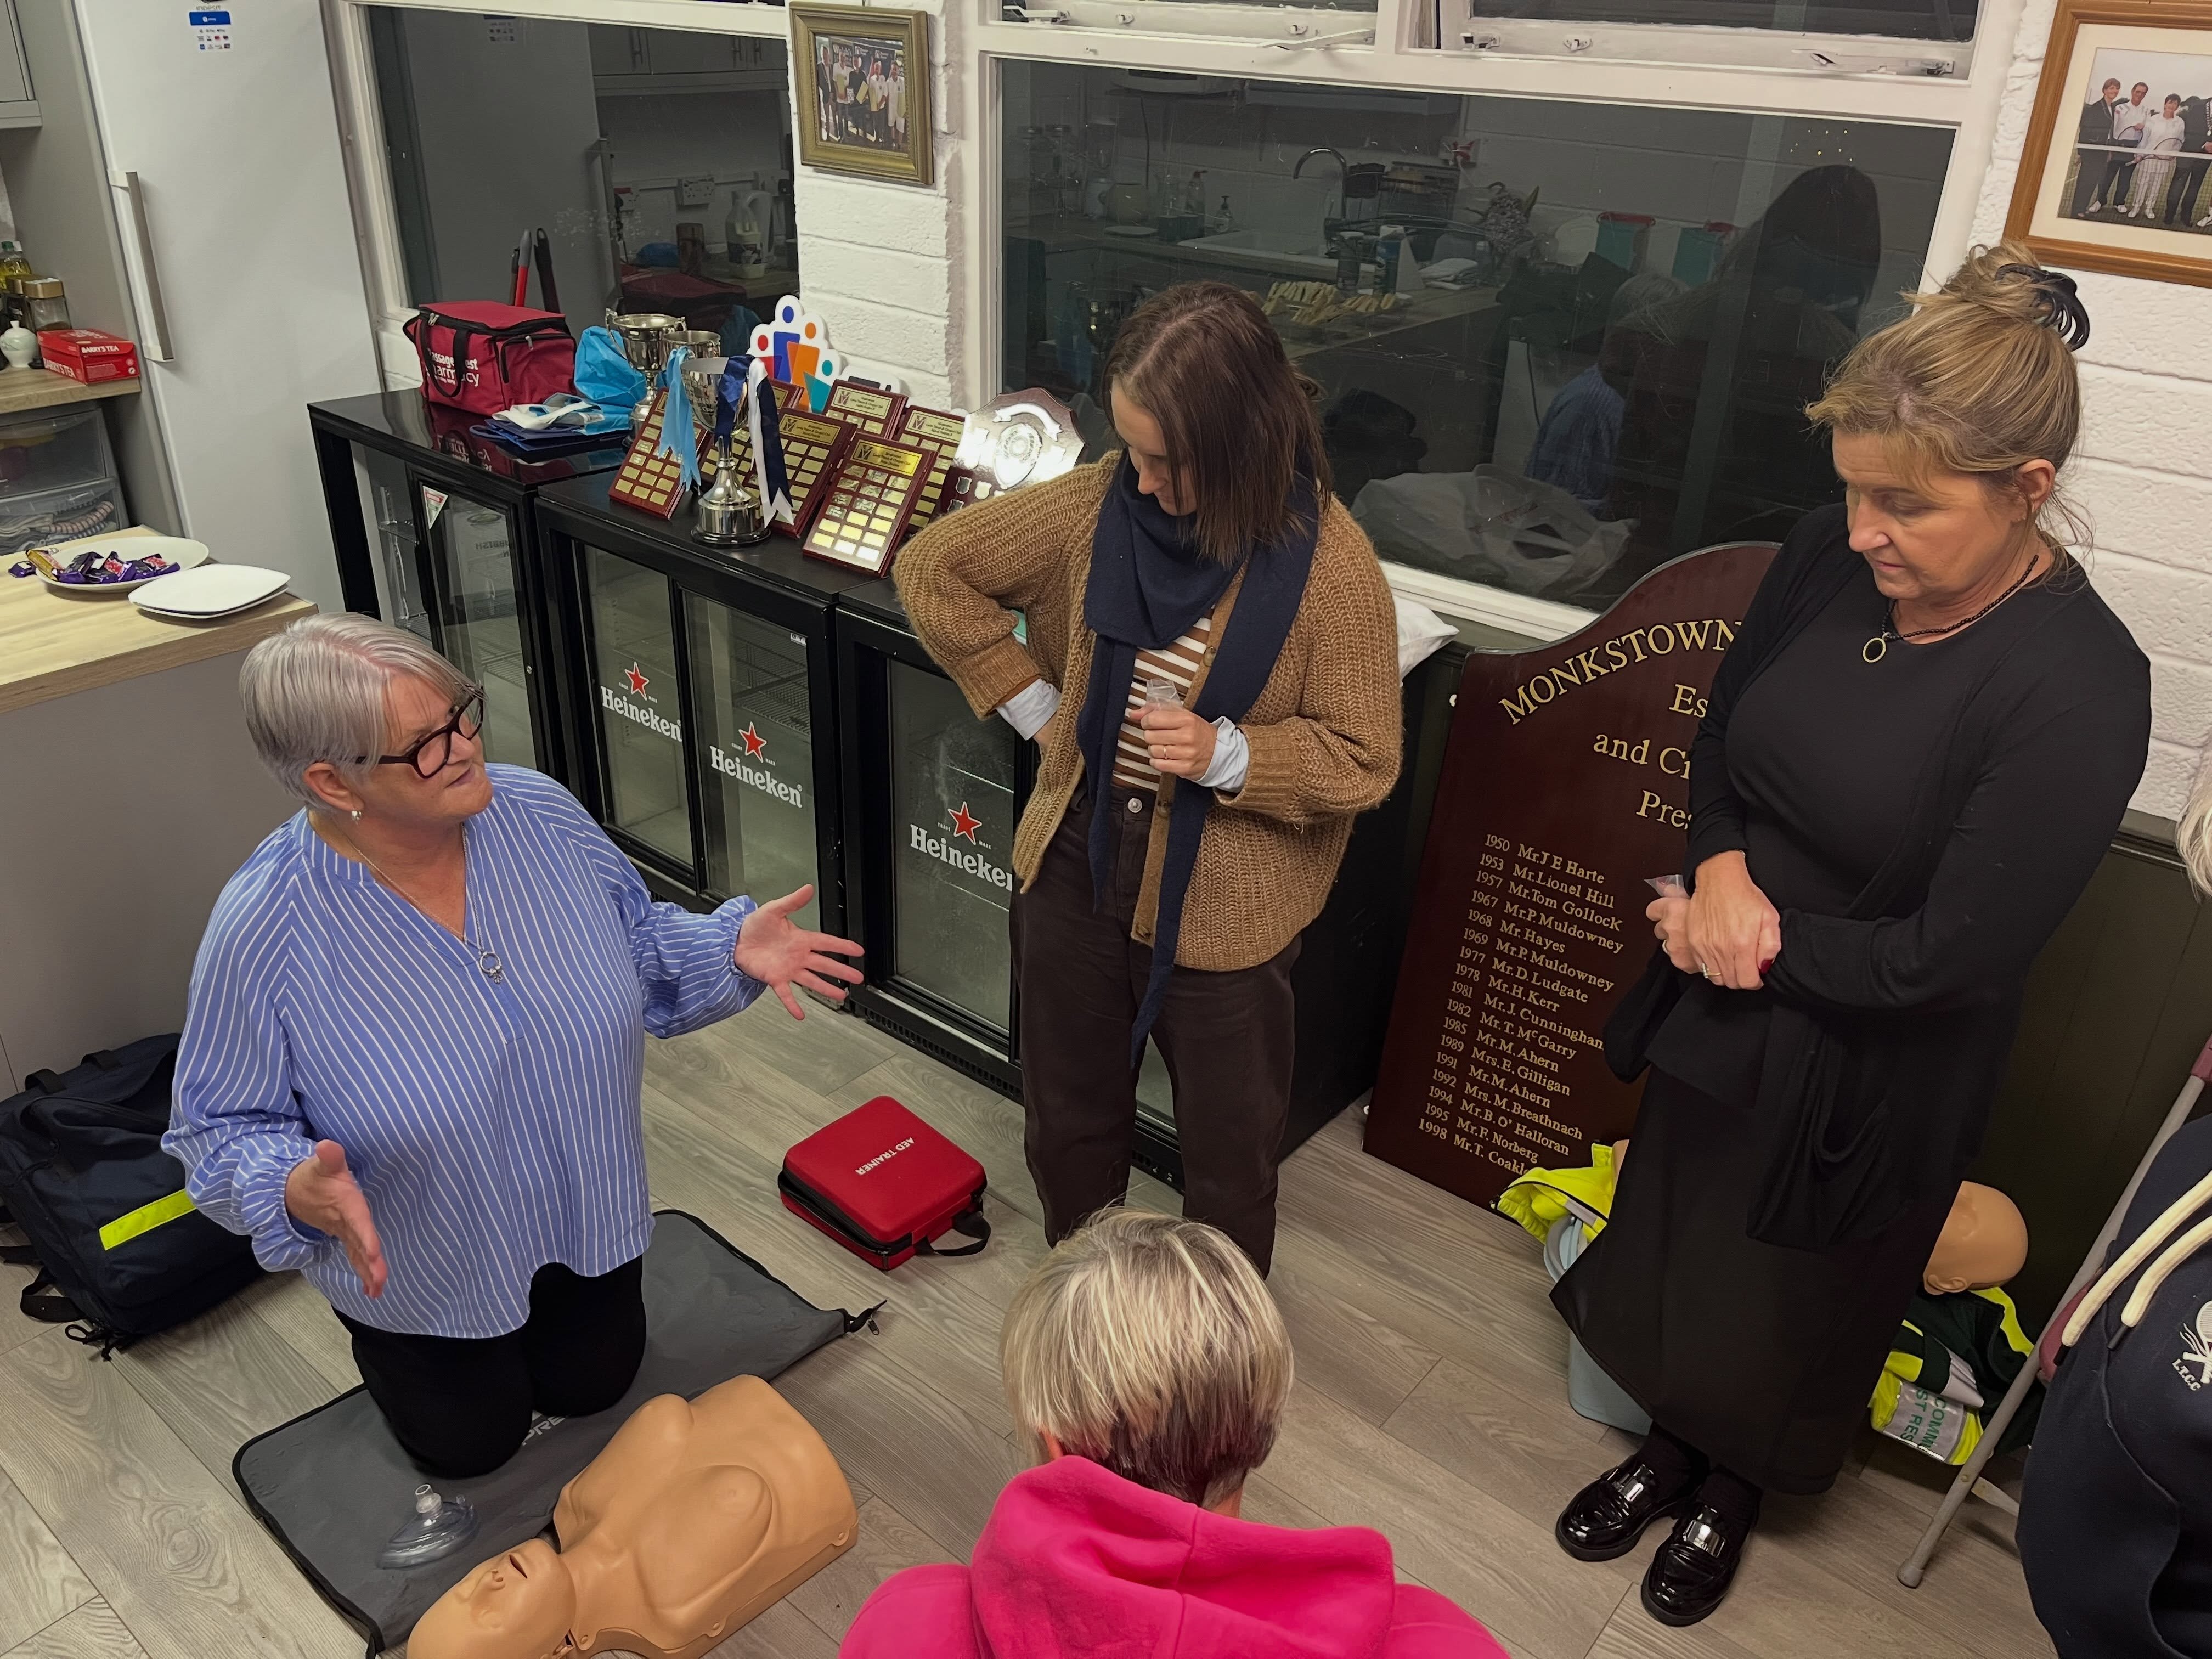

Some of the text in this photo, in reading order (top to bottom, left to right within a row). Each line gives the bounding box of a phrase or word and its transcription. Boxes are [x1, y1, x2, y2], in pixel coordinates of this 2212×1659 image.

[1498, 619, 1742, 725] MONKSTOWN
[601, 685, 682, 742] Heineken
[709, 745, 803, 808] Heineken
[1593, 733, 1650, 765] and
[937, 822, 991, 849] TRADE MARK
[1485, 834, 1510, 852] 1950
[1565, 860, 1605, 884] Harte
[1476, 870, 1503, 888] 1957
[1480, 853, 1504, 871] 1953
[1585, 887, 1614, 909] Hill
[1468, 909, 1493, 927] 1968
[1523, 928, 1566, 953] Hayes
[1471, 890, 1498, 908] 1967
[1538, 912, 1624, 954] Muldowney
[1455, 963, 1480, 981] 1978
[1459, 946, 1486, 963] 1977
[1531, 972, 1588, 1003] Ludgate
[1463, 928, 1488, 944] 1969
[1529, 950, 1615, 992] Muldowney
[1447, 998, 1471, 1018] 1982
[1451, 981, 1473, 999] 1981
[1441, 1034, 1464, 1052] 1989
[1517, 1066, 1570, 1096] Gilligan
[1443, 1017, 1468, 1035] 1985
[1516, 1047, 1559, 1073] Ahern
[1432, 1069, 1457, 1088] 1992
[1436, 1051, 1458, 1069] 1991
[1508, 1082, 1550, 1109] Ahern
[1418, 1118, 1448, 1140] 1998
[1425, 1103, 1451, 1121] 1995
[1491, 1131, 1539, 1164] Norberg
[1428, 1086, 1453, 1105] 1994
[1514, 1122, 1569, 1156] Halloran
[855, 1137, 915, 1175] AED TRAINER
